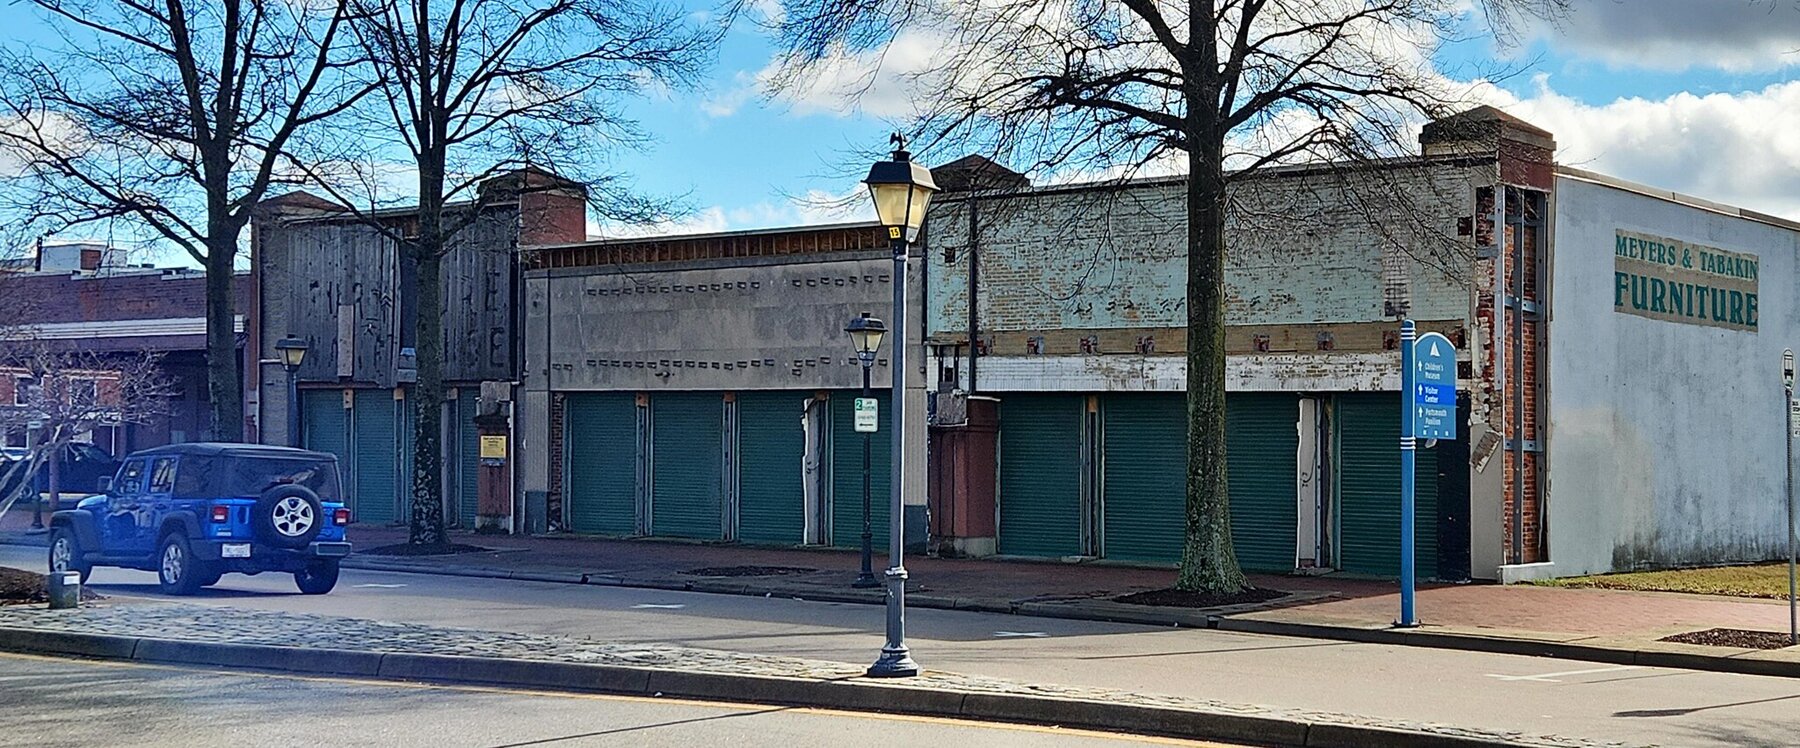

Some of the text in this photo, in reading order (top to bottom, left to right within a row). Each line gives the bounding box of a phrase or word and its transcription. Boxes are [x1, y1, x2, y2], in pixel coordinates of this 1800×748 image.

[1615, 234, 1758, 279] MEYERS & TABAKIN
[1615, 271, 1758, 327] FURNITURE
[856, 400, 862, 409] 2
[1424, 395, 1438, 403] Center
